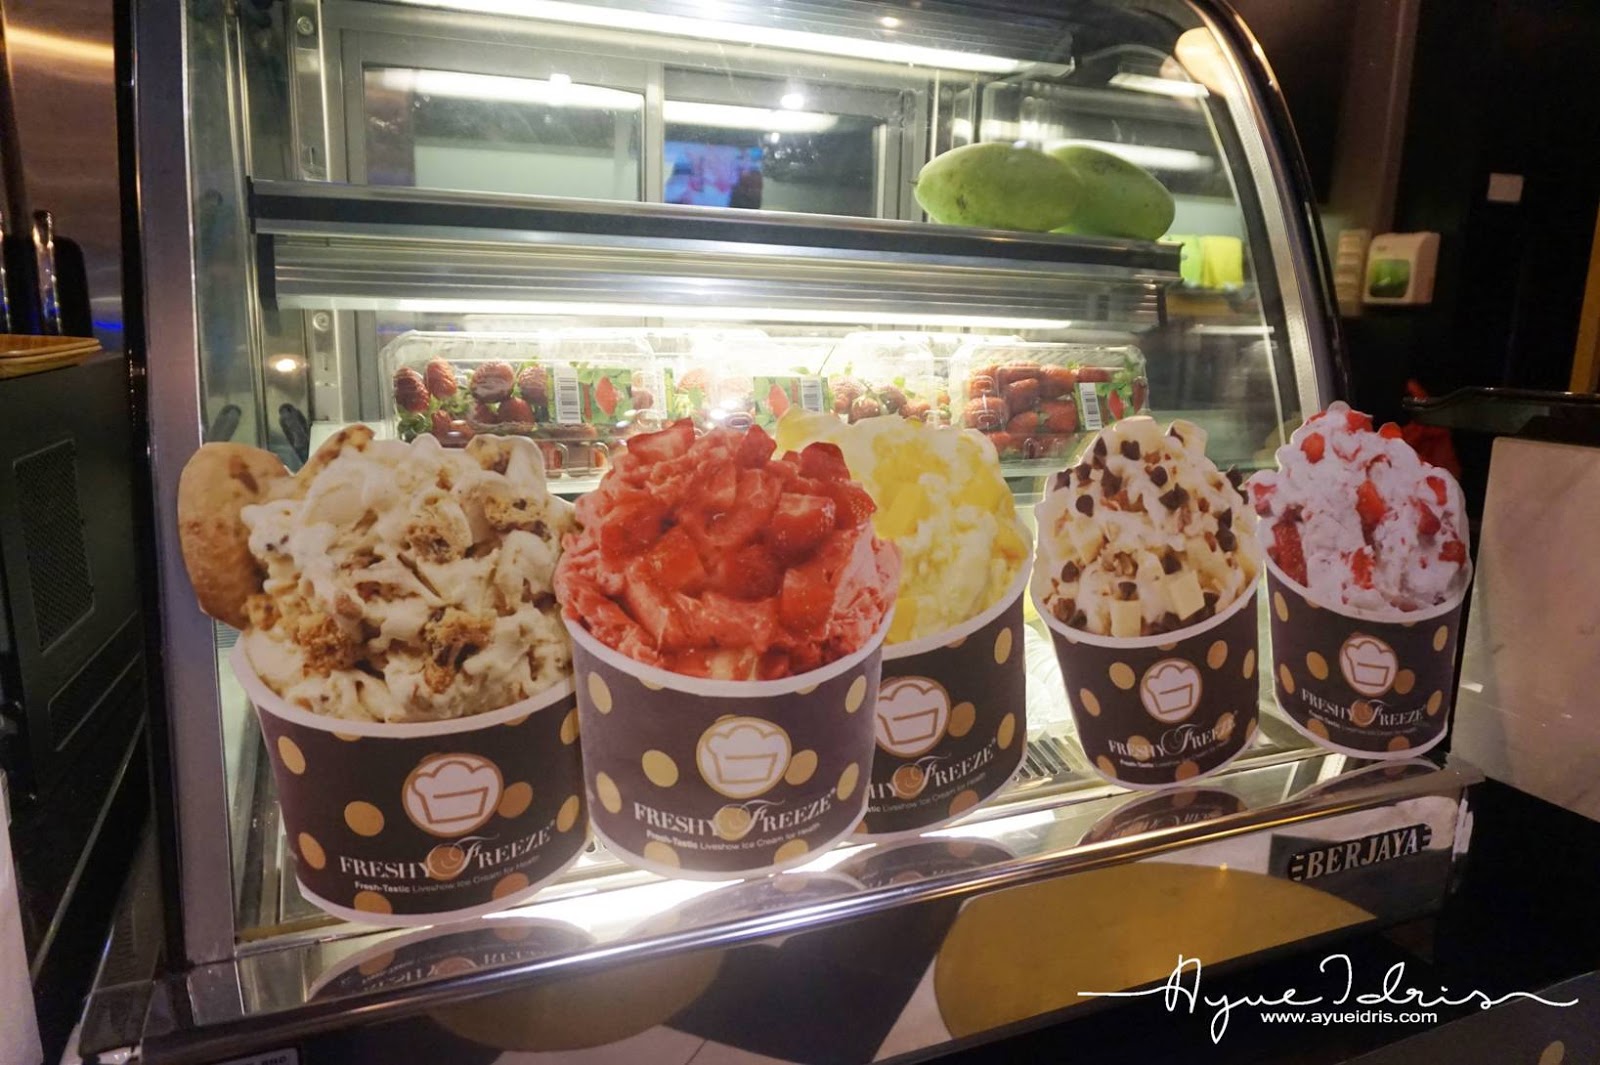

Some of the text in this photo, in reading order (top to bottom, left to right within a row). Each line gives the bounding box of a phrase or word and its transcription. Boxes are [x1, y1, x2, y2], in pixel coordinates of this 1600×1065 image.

[1301, 687, 1354, 721] FRESHY
[1352, 699, 1424, 727] FREEZE
[892, 747, 994, 799] FREEZE
[633, 797, 832, 840] FRESHY FREEZE
[340, 829, 551, 880] FRESHY FREEZE
[1306, 828, 1418, 880] BERJAYA
